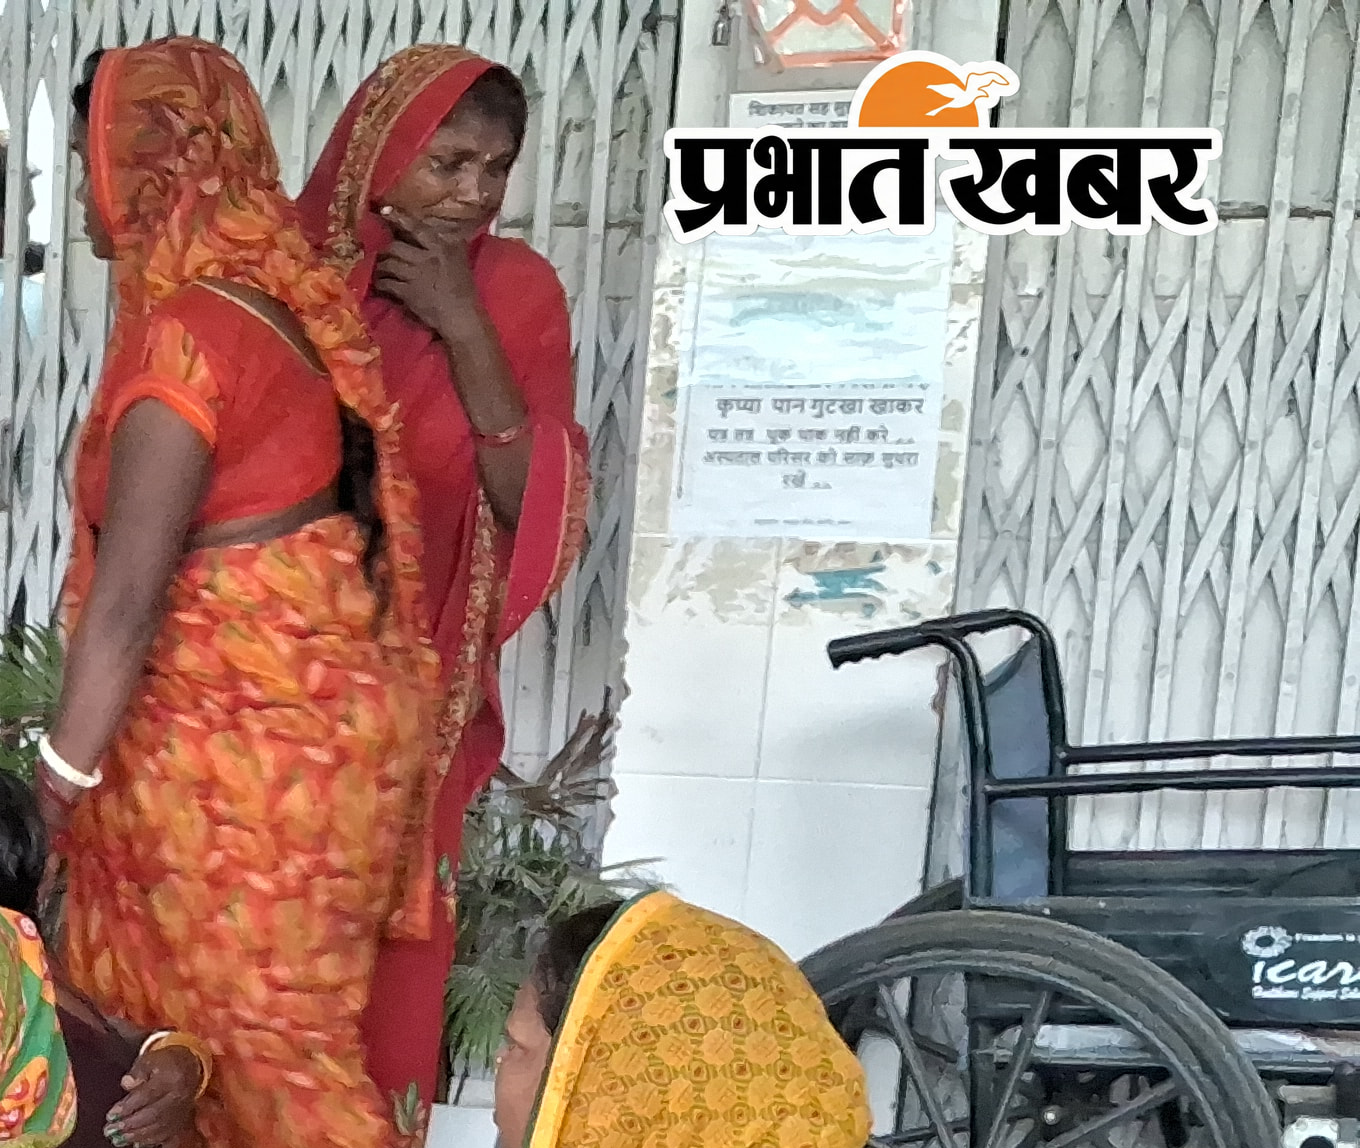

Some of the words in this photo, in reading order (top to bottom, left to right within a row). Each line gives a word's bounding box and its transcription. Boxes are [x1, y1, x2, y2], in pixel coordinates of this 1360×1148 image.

[771, 398, 806, 414] पान
[808, 398, 863, 418] गुटखा
[868, 398, 925, 414] खाकर
